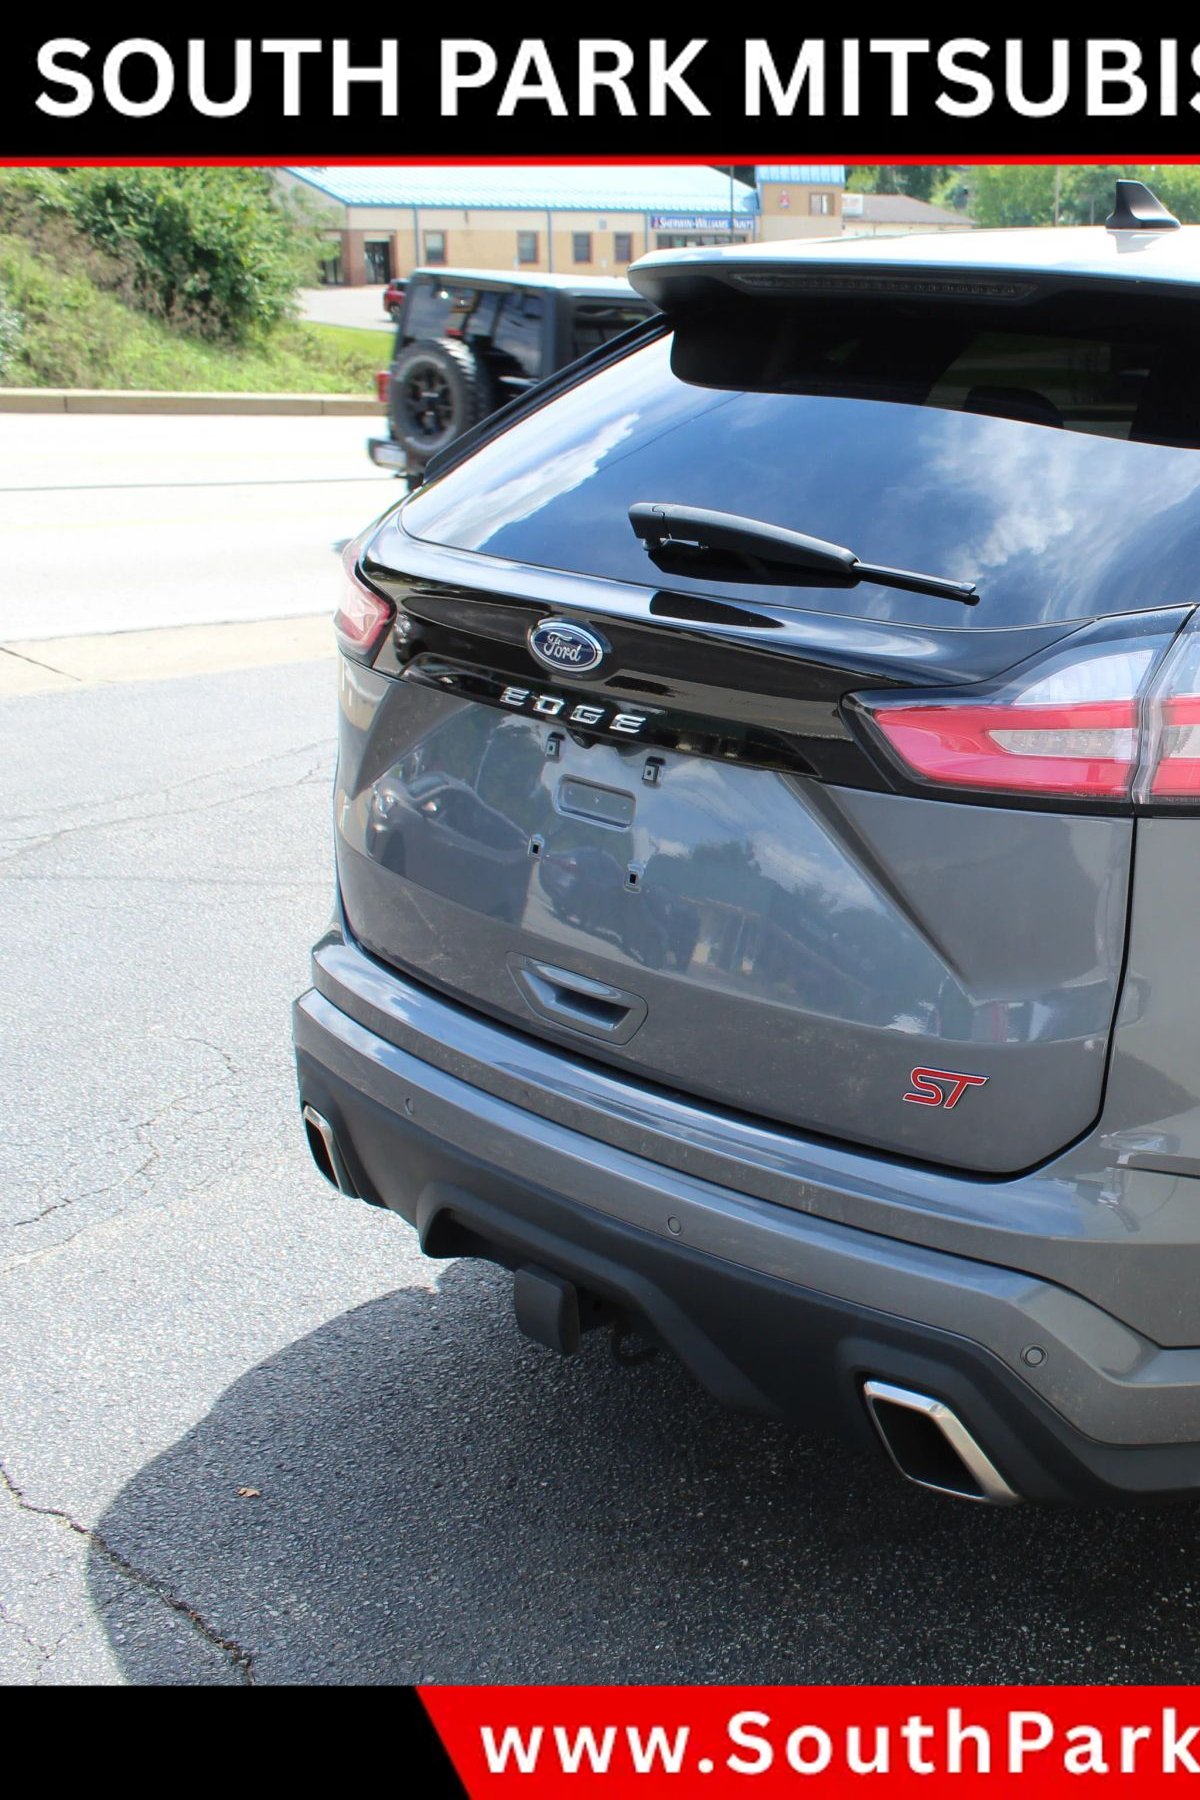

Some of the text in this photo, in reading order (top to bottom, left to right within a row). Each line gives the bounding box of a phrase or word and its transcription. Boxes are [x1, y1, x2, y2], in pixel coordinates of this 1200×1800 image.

[543, 630, 583, 663] Ford
[500, 686, 647, 734] EDGE
[902, 1066, 989, 1109] ST
